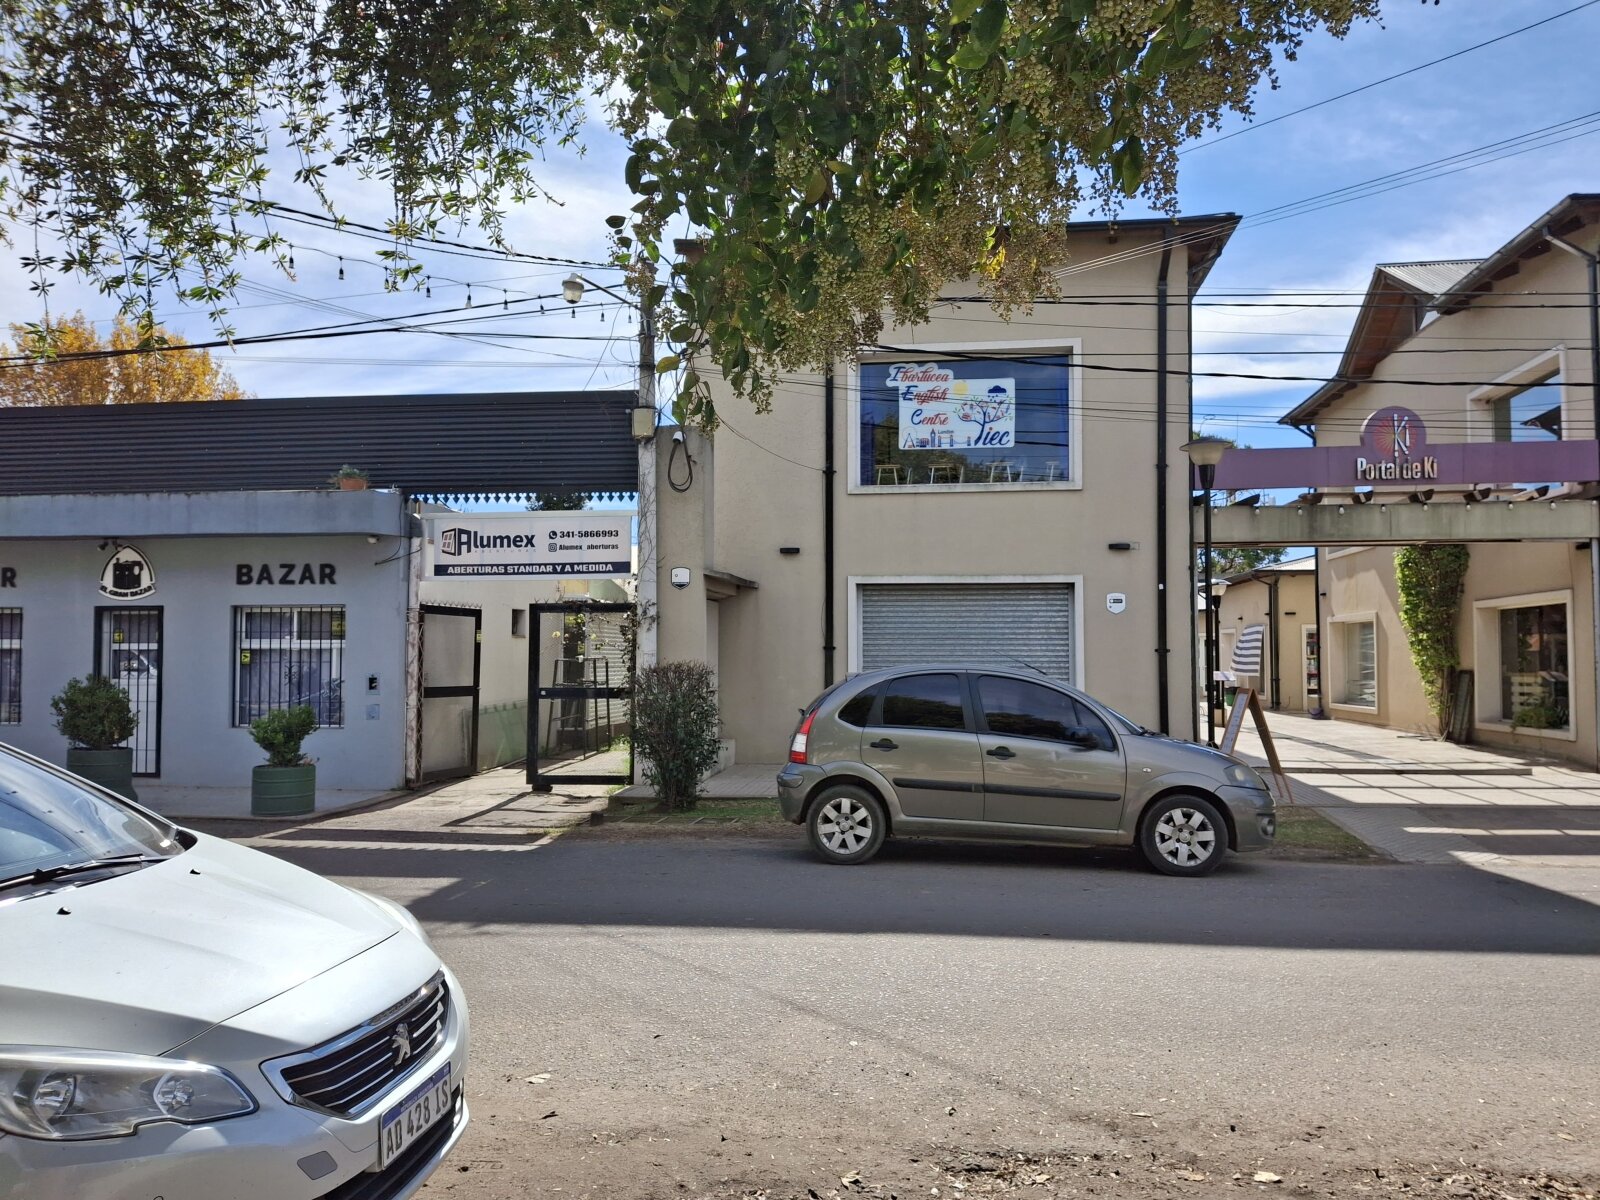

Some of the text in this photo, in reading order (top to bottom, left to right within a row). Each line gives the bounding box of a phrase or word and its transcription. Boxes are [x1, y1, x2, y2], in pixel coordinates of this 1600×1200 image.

[901, 385, 948, 405] English
[911, 409, 949, 425] Centre
[1356, 456, 1438, 480] Portal de Ki
[457, 527, 536, 556] Alumex
[559, 529, 619, 539] 341-5866993
[235, 563, 337, 585] BAZAR
[447, 566, 505, 574] ABERTURAS
[507, 564, 553, 573] STANDAR
[564, 564, 574, 572] A
[574, 563, 613, 572] MEDIDA
[386, 1119, 402, 1159] AD
[406, 1095, 431, 1137] 428
